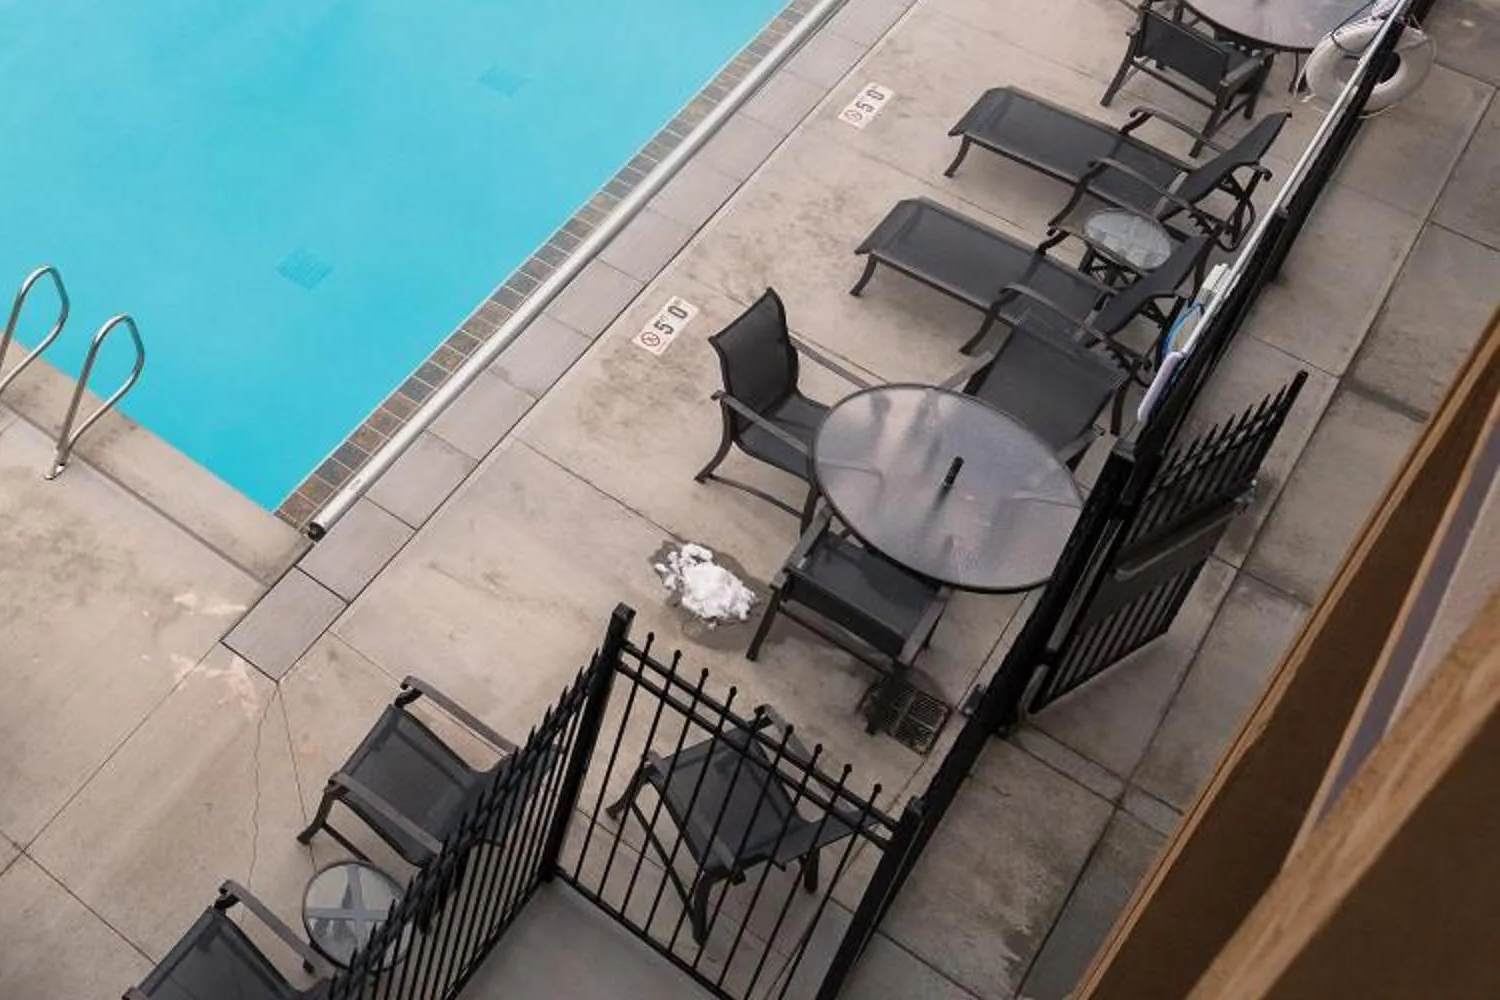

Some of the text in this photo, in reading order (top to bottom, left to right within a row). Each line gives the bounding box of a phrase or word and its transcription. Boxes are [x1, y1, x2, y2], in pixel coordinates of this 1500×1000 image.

[855, 89, 885, 113] 5 0
[654, 320, 675, 335] 5
[667, 305, 688, 319] 0
